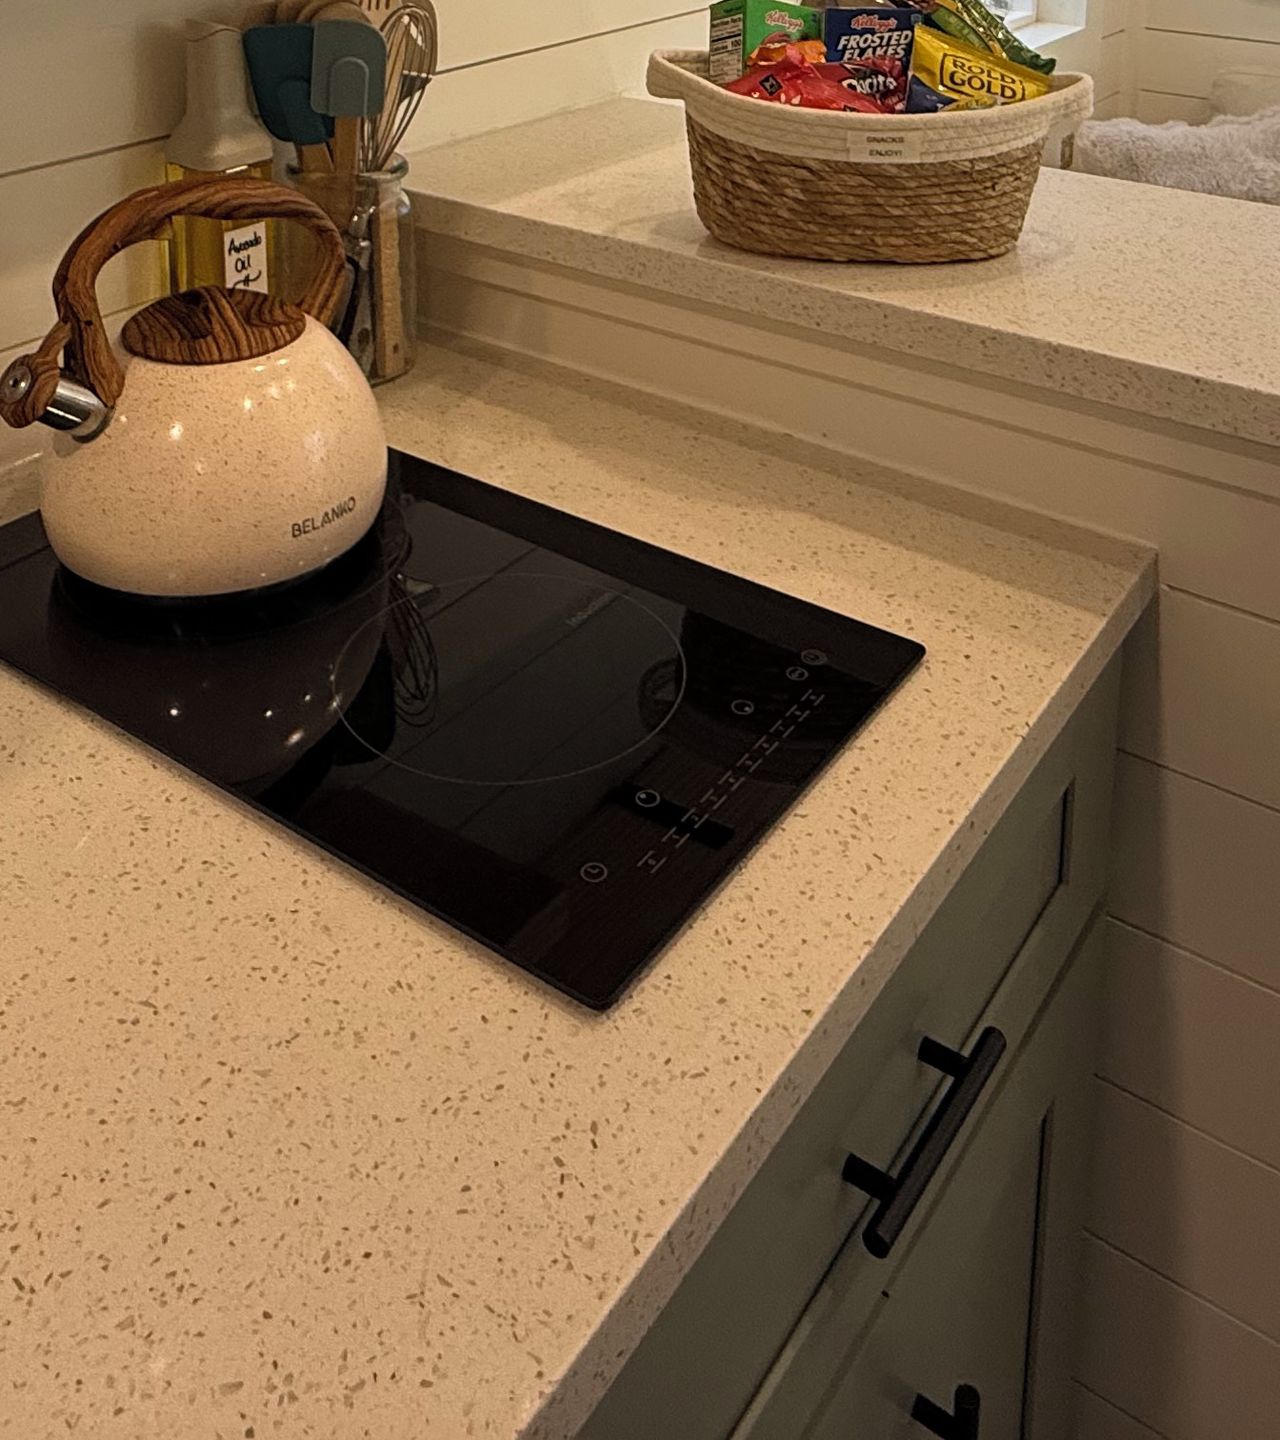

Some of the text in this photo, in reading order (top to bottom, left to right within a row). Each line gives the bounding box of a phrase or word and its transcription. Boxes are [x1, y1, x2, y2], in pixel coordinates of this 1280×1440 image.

[837, 30, 913, 50] FROSTED
[842, 45, 907, 62] FLAKES
[952, 59, 1017, 85] ROLD
[949, 70, 1017, 100] GOLD
[228, 231, 262, 256] Avocado
[235, 254, 251, 273] Oil
[291, 496, 356, 538] BELANKO
